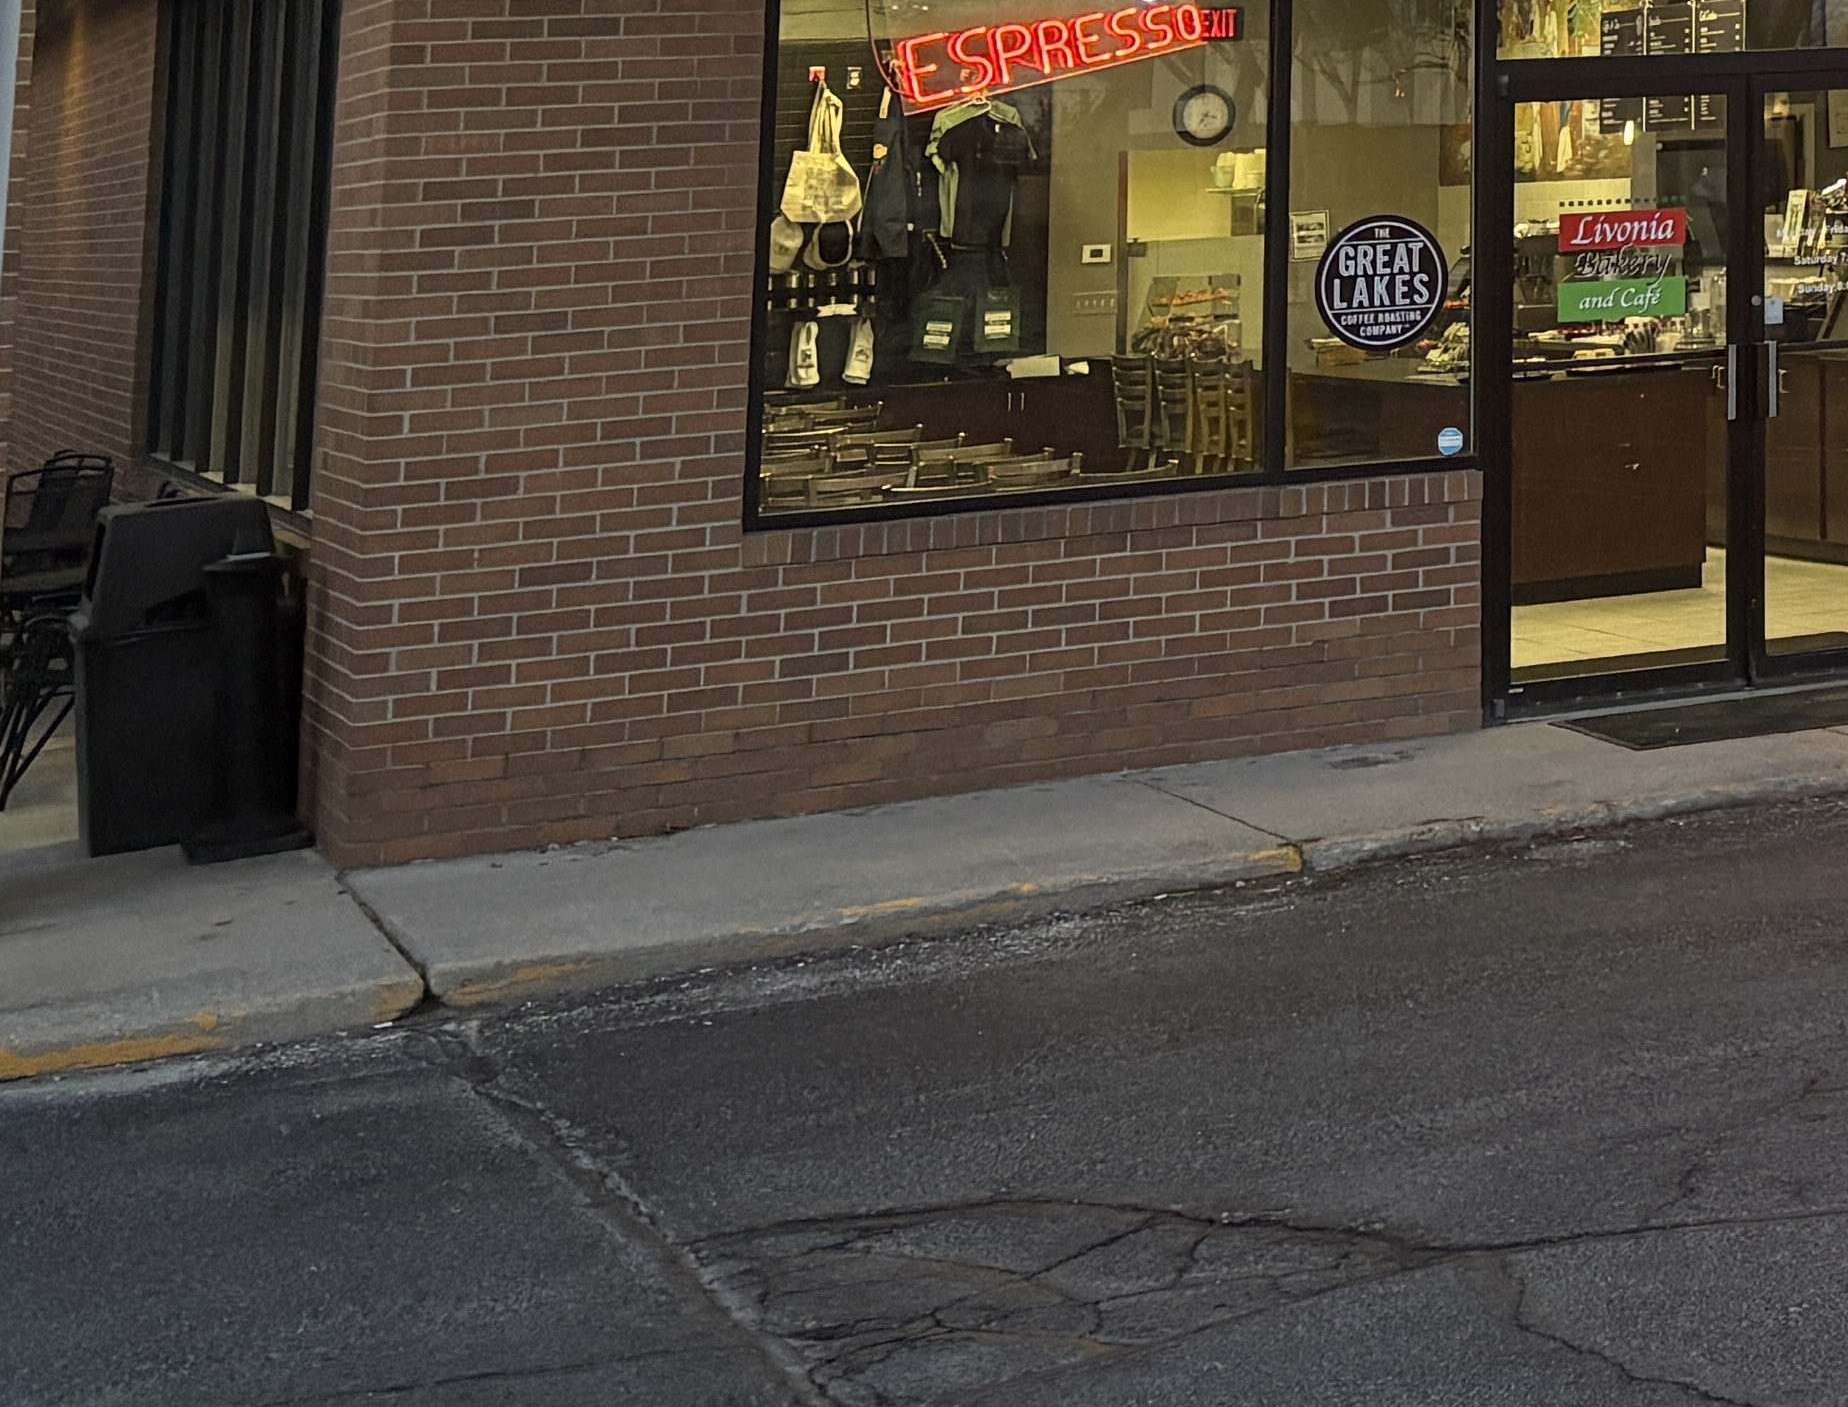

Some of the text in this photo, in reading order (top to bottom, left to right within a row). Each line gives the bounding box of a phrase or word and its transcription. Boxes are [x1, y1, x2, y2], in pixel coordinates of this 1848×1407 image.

[1201, 9, 1238, 38] EXIT
[904, 2, 1202, 104] ESPRESSO
[1374, 227, 1391, 239] THE
[1570, 212, 1675, 245] Livonia
[1338, 242, 1425, 277] GREAT
[1574, 242, 1673, 287] Bakery
[1794, 253, 1838, 266] Saturday
[1333, 273, 1430, 310] LAKES
[1579, 287, 1662, 314] and Café
[1798, 281, 1836, 294] Sunday
[1340, 310, 1422, 326] COFFEE ROASTING
